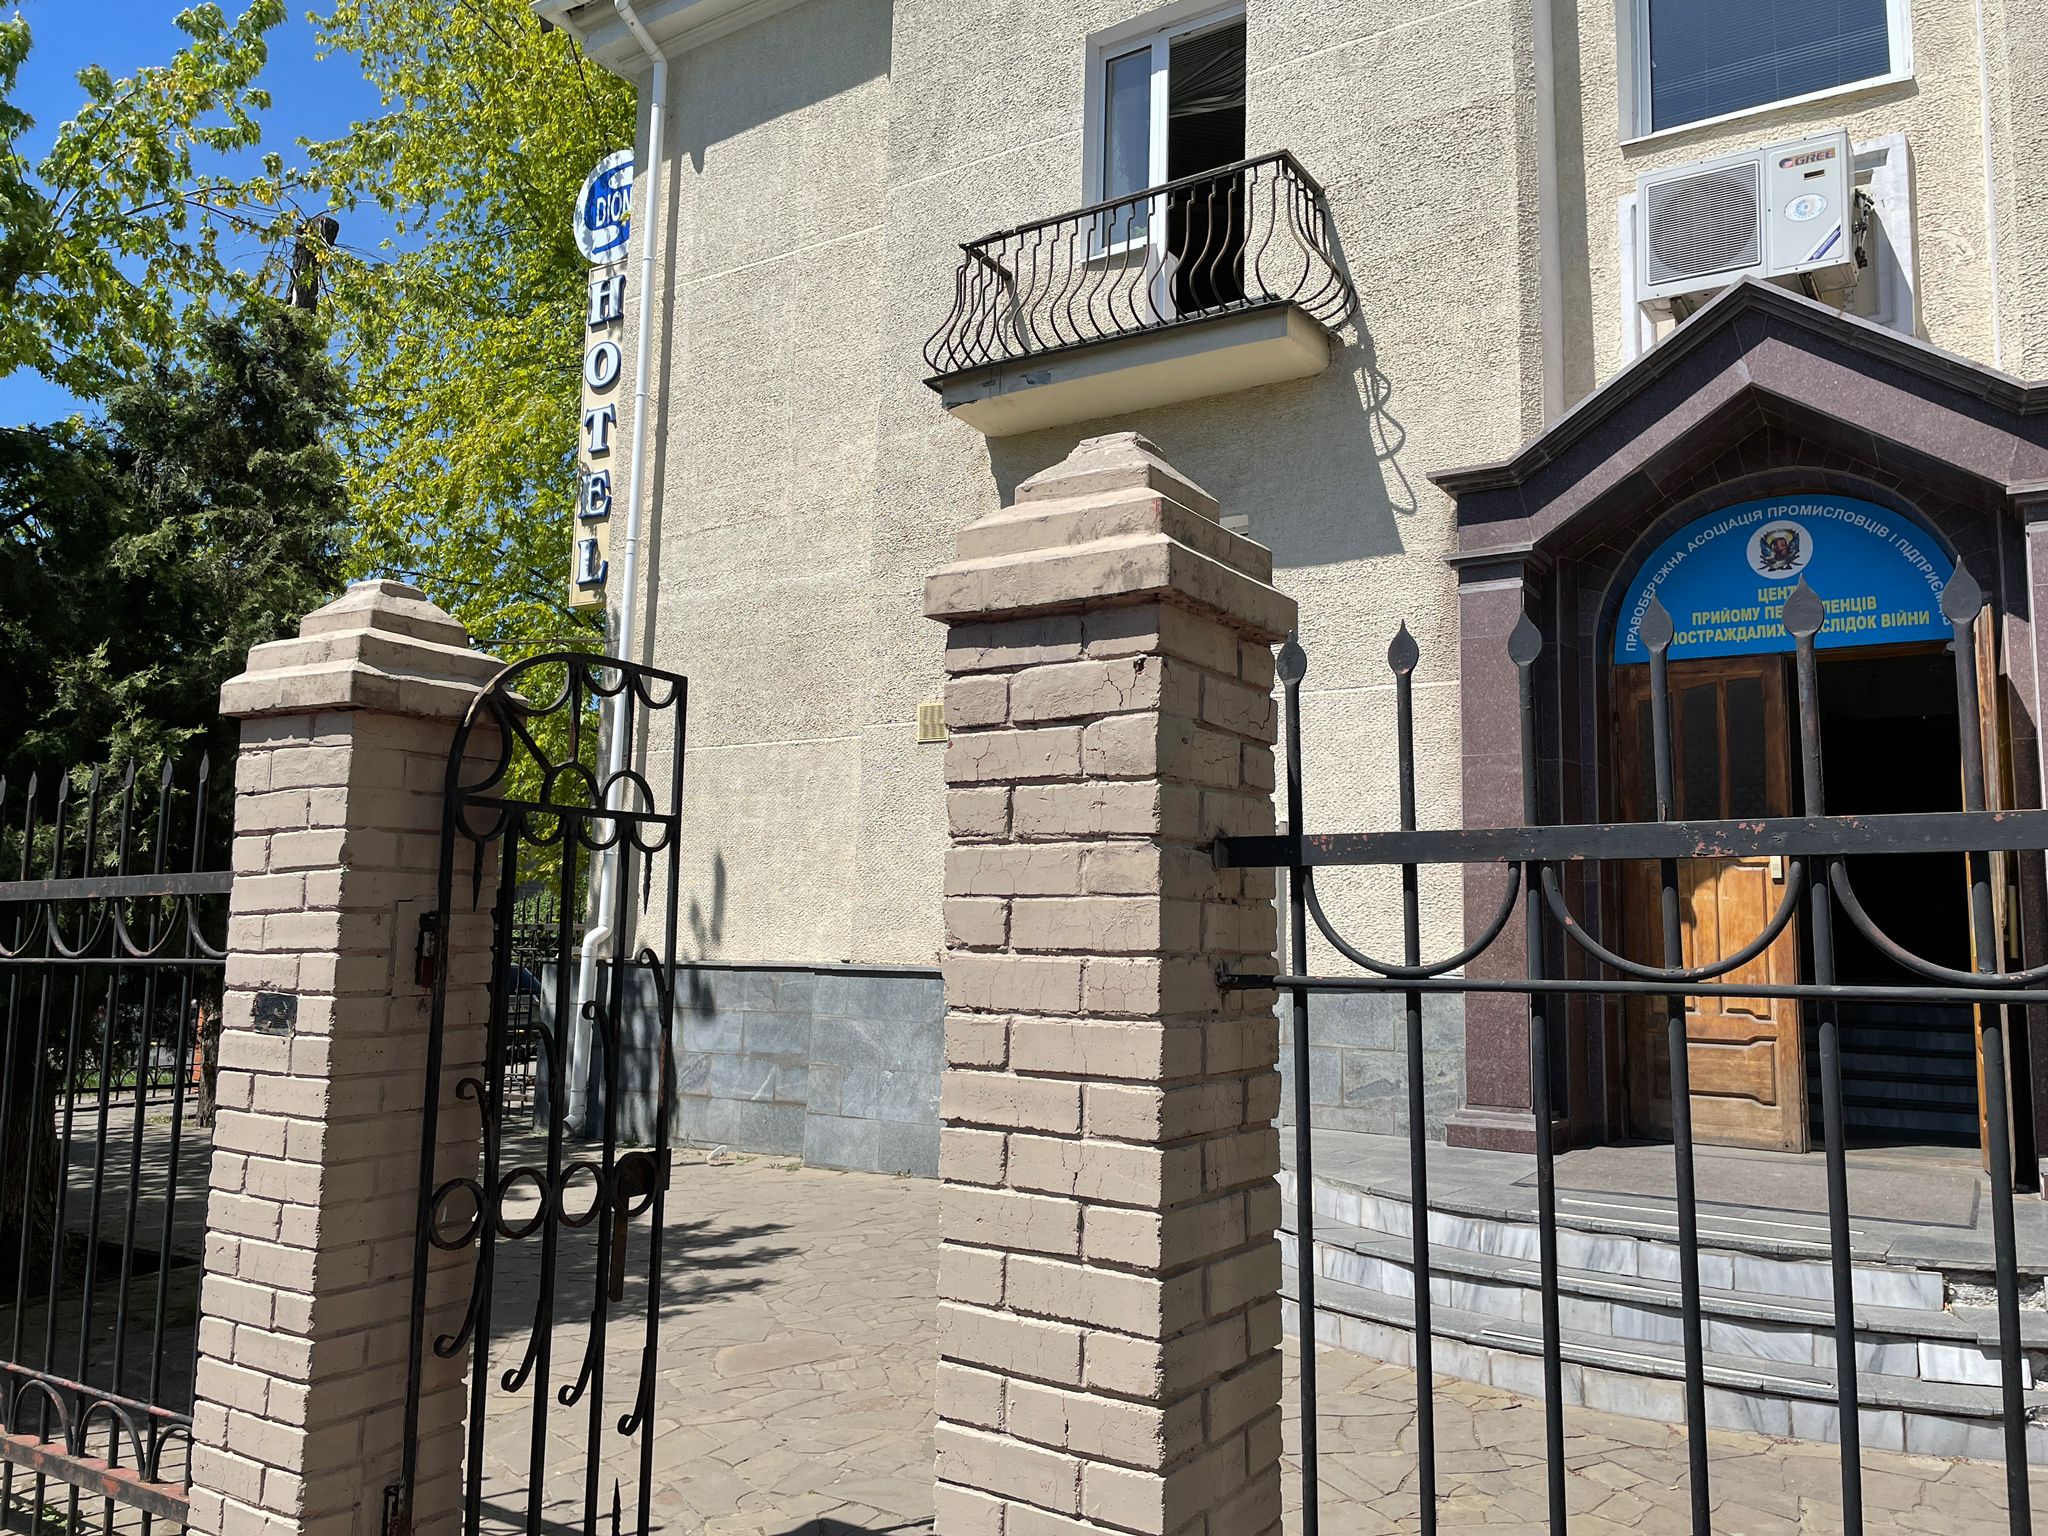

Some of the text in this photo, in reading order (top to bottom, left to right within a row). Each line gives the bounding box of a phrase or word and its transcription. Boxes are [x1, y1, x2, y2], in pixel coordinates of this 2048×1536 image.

[1795, 148, 1835, 166] GREE
[576, 274, 626, 587] HOTEL
[1625, 551, 1687, 652] ПРАВОБЕРЕЖНА
[1686, 509, 1764, 553] АСОЦІАЦІЯ
[1767, 504, 1890, 538] ПРОМИСЛОВЦІВ
[1692, 607, 1760, 626] ПРИЙОМУ
[1881, 609, 1930, 628] ВІЙНИ
